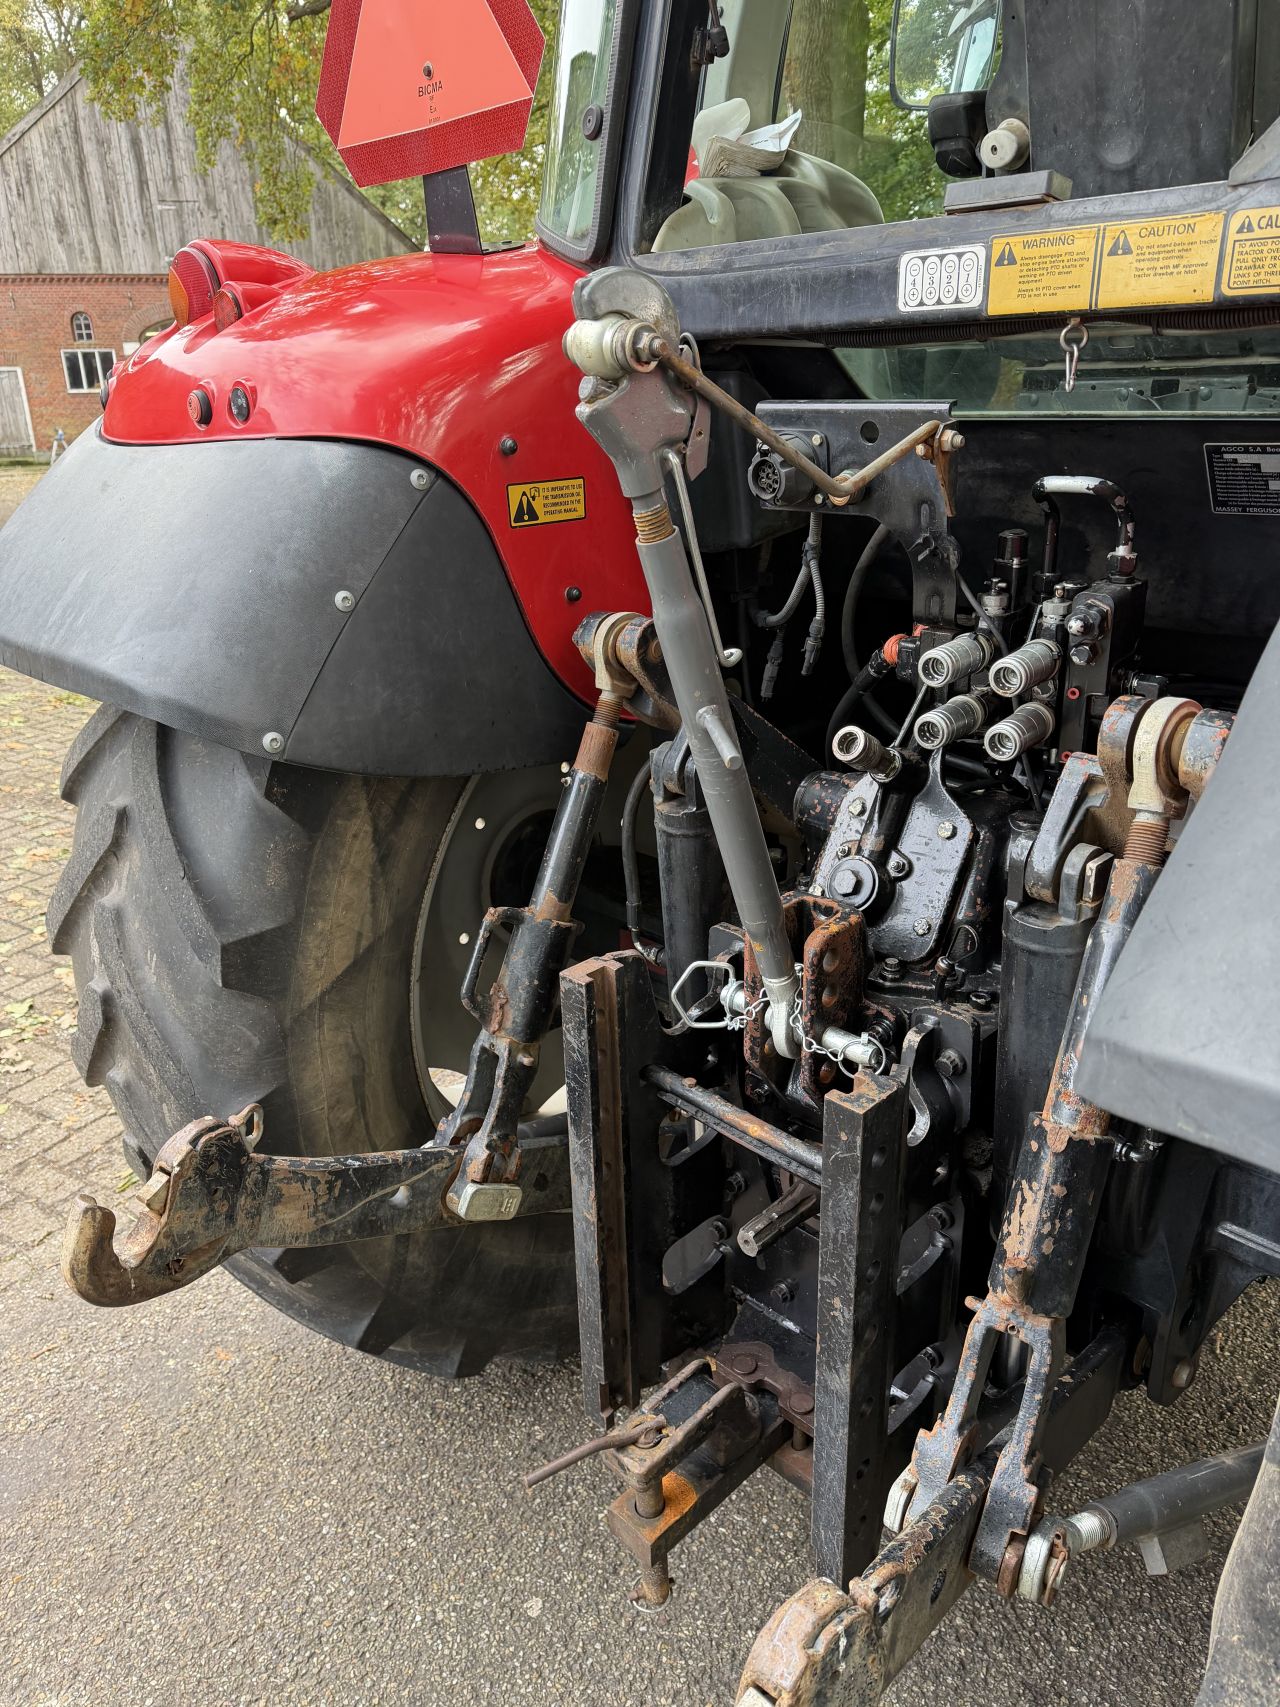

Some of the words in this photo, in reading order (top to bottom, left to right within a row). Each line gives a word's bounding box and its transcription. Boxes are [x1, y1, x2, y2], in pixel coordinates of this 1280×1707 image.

[1138, 222, 1197, 238] CAUTION
[1022, 234, 1075, 249] WARNING
[910, 278, 916, 287] 4
[929, 276, 934, 286] 3
[946, 275, 952, 284] 2
[965, 273, 970, 282] 1
